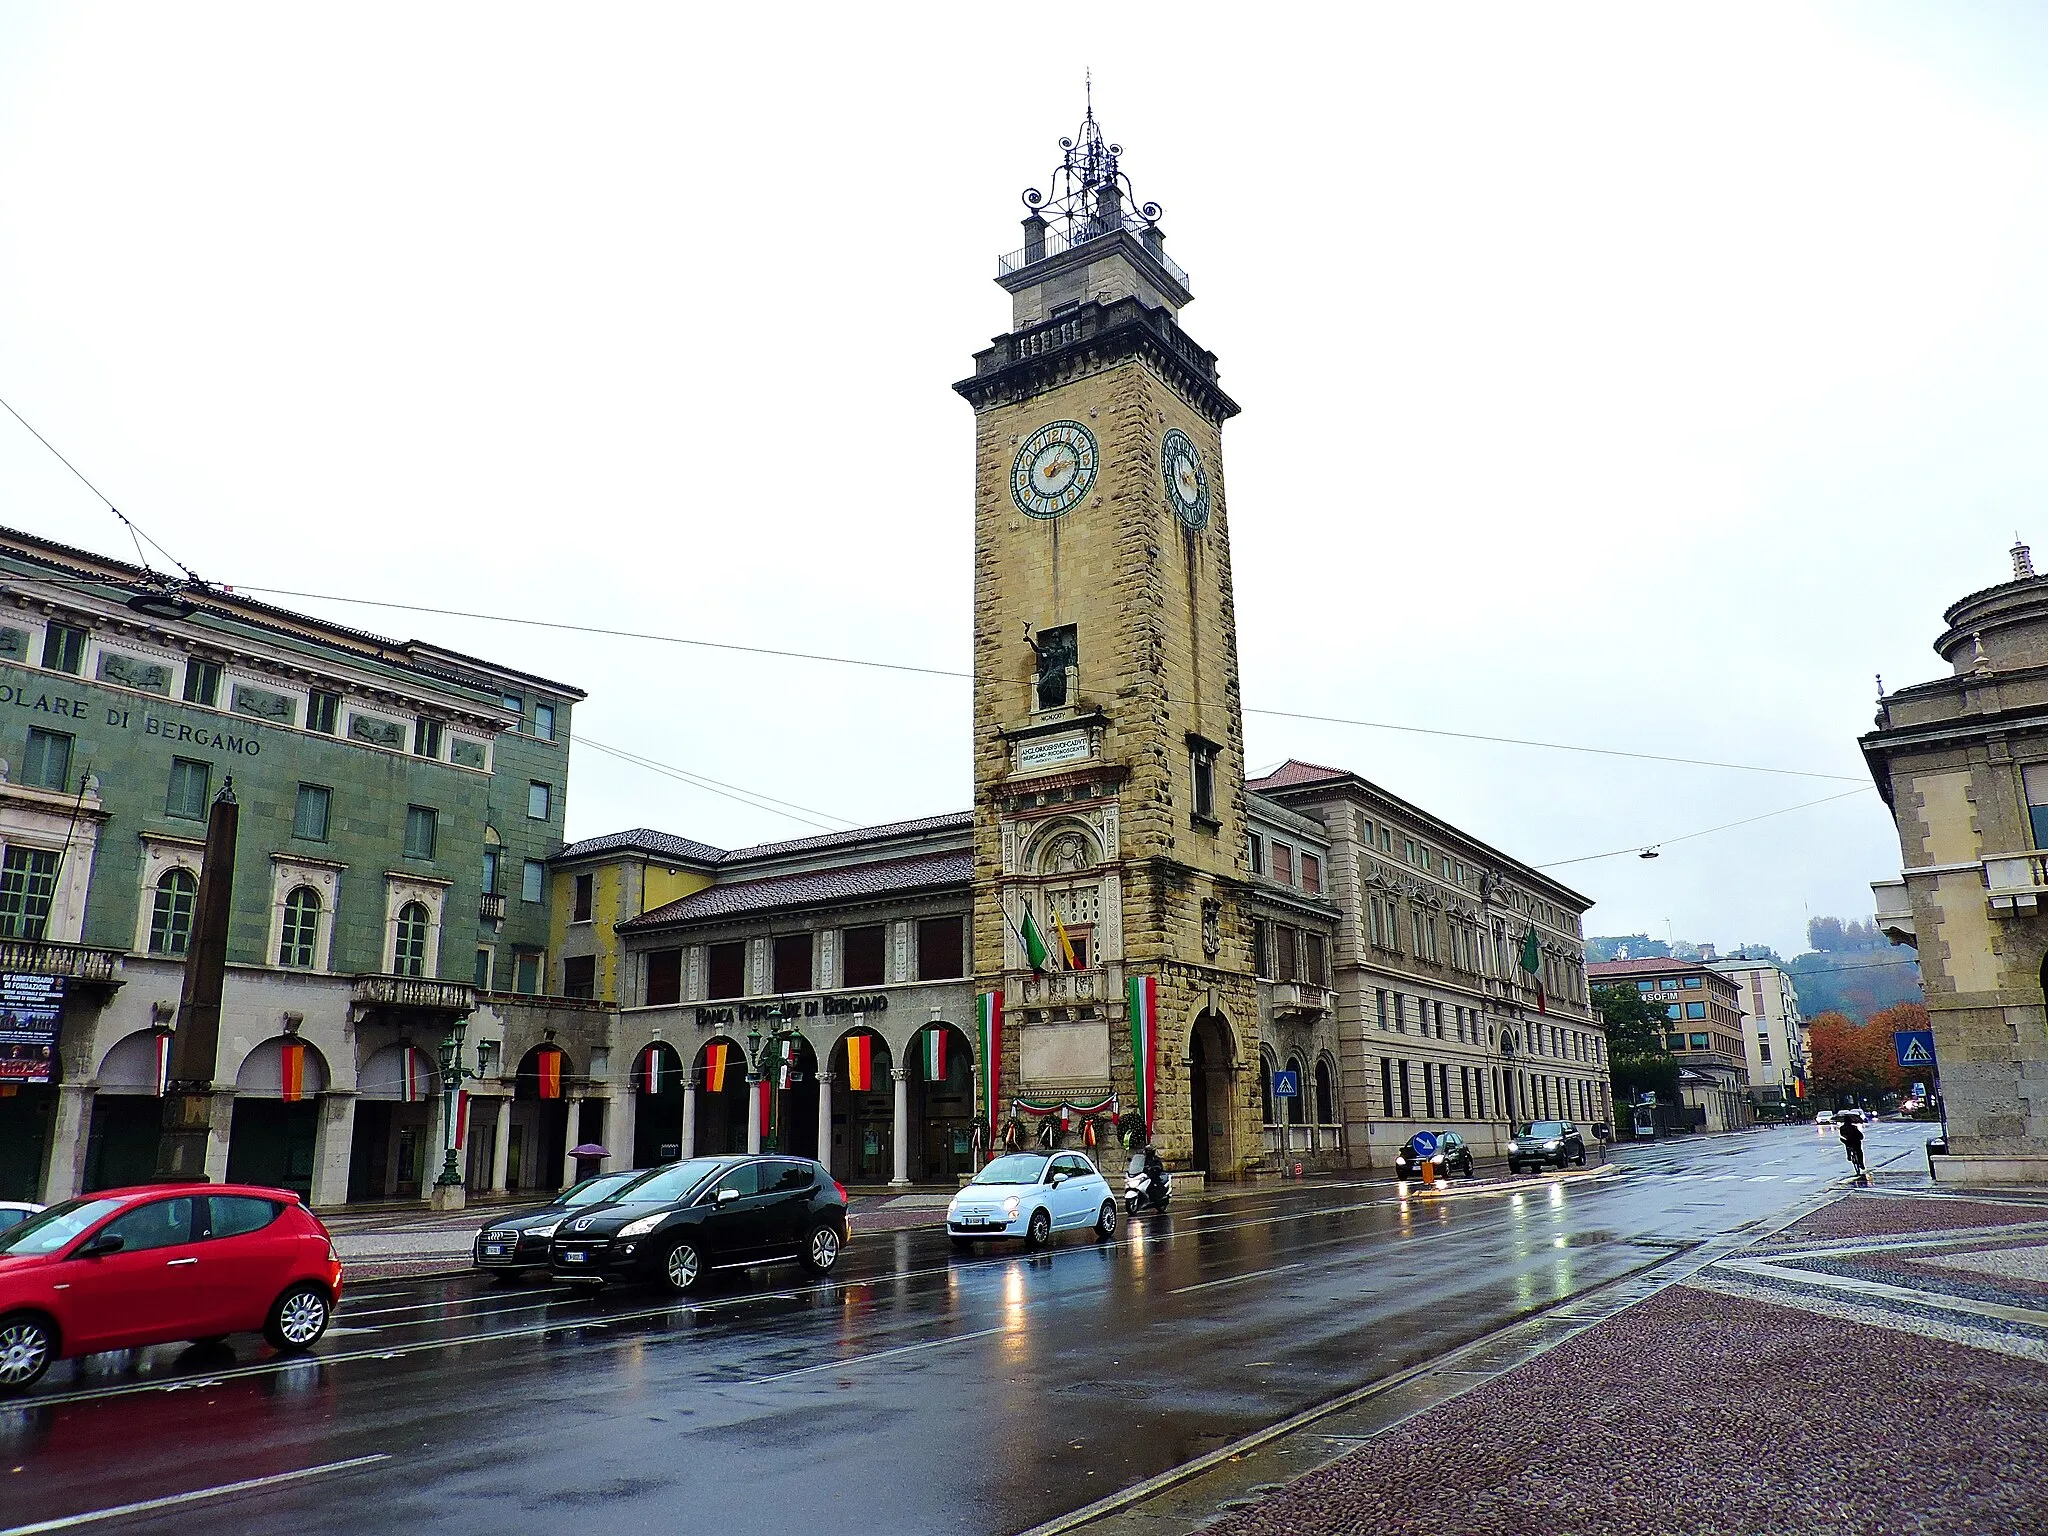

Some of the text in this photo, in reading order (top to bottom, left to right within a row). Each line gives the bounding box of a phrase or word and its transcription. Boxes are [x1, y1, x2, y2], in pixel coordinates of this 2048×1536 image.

[1048, 430, 1059, 443] 12
[1078, 437, 1085, 448] 2
[1033, 440, 1042, 453] 11
[1022, 454, 1032, 469] 10
[1020, 474, 1026, 485] 9
[1078, 473, 1085, 485] 4
[1024, 490, 1031, 501] 8
[1067, 489, 1075, 501] 5
[1036, 499, 1042, 511] 7
[1051, 499, 1058, 510] 6
[0, 684, 260, 756] OLARE DI BERGAMO
[12, 982, 50, 991] FONDAZIONE
[1647, 992, 1678, 1001] SOFIM
[696, 995, 889, 1025] BANCA POPOARE DI BERGAMO
